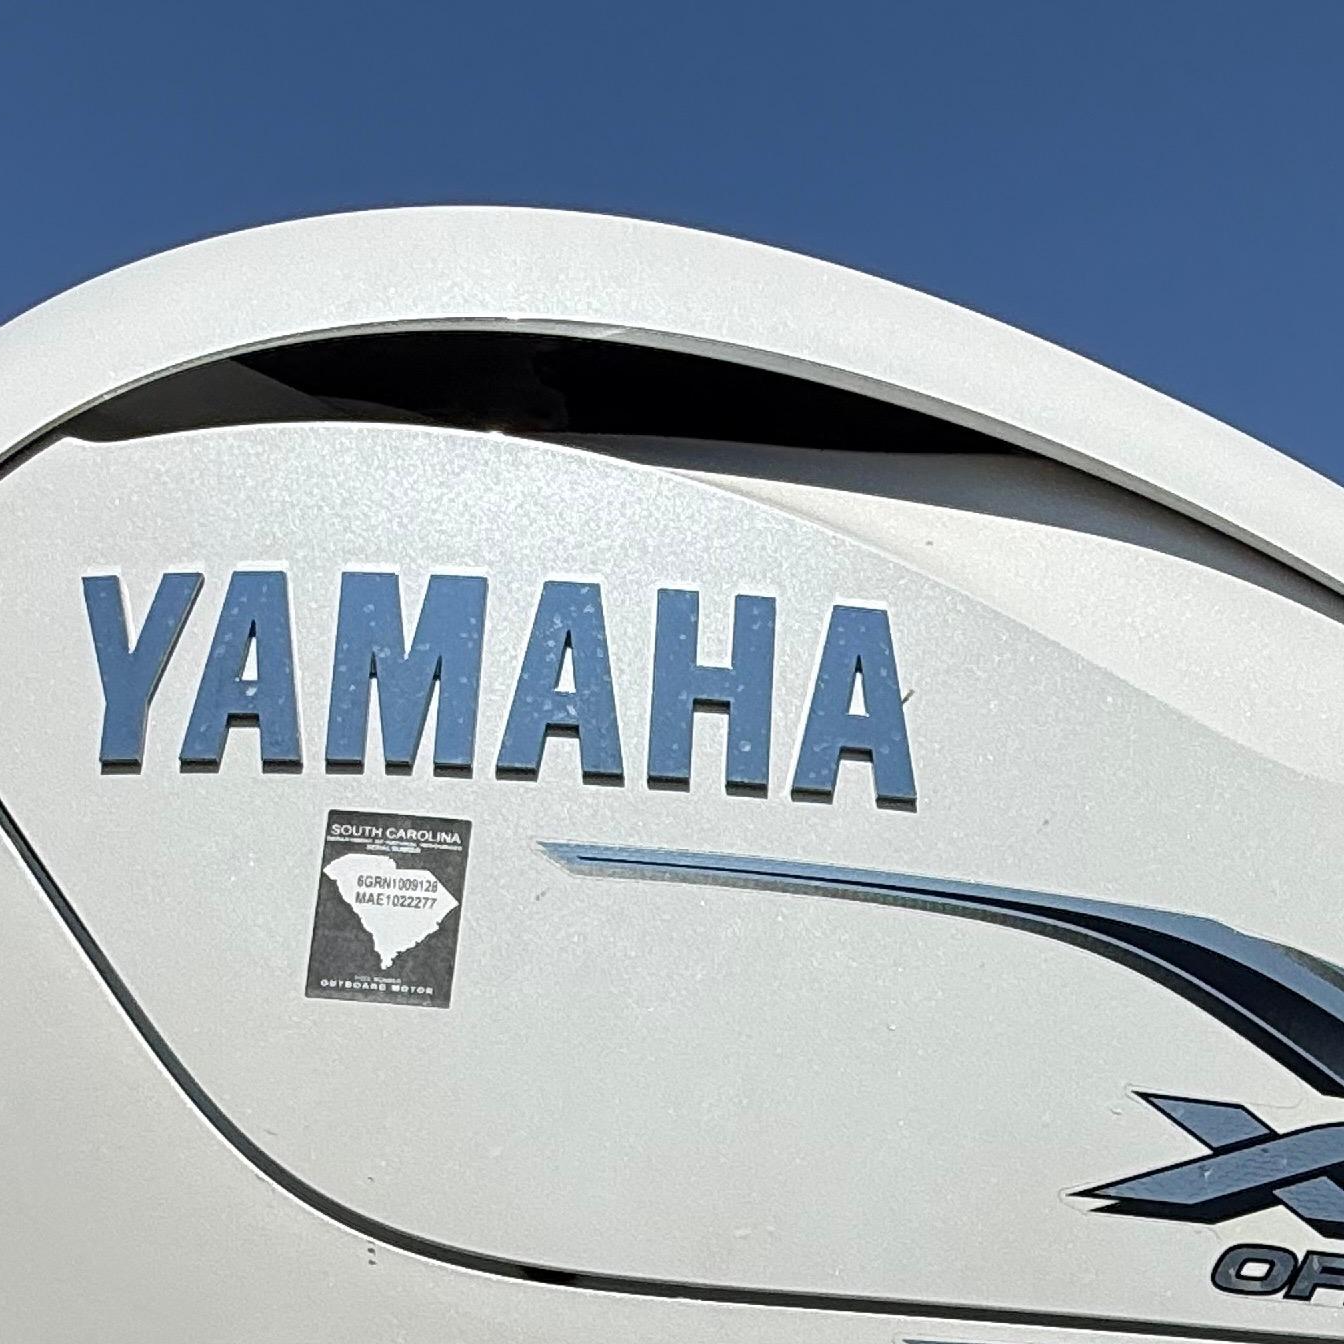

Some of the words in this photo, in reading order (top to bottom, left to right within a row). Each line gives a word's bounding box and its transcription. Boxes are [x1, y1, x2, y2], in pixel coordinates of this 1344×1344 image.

[82, 569, 917, 812] YAMAHA
[331, 824, 384, 837] SOUTH
[385, 827, 462, 844] CAROLINA
[355, 891, 437, 909] MAE1022277
[391, 983, 434, 995] MOTOR
